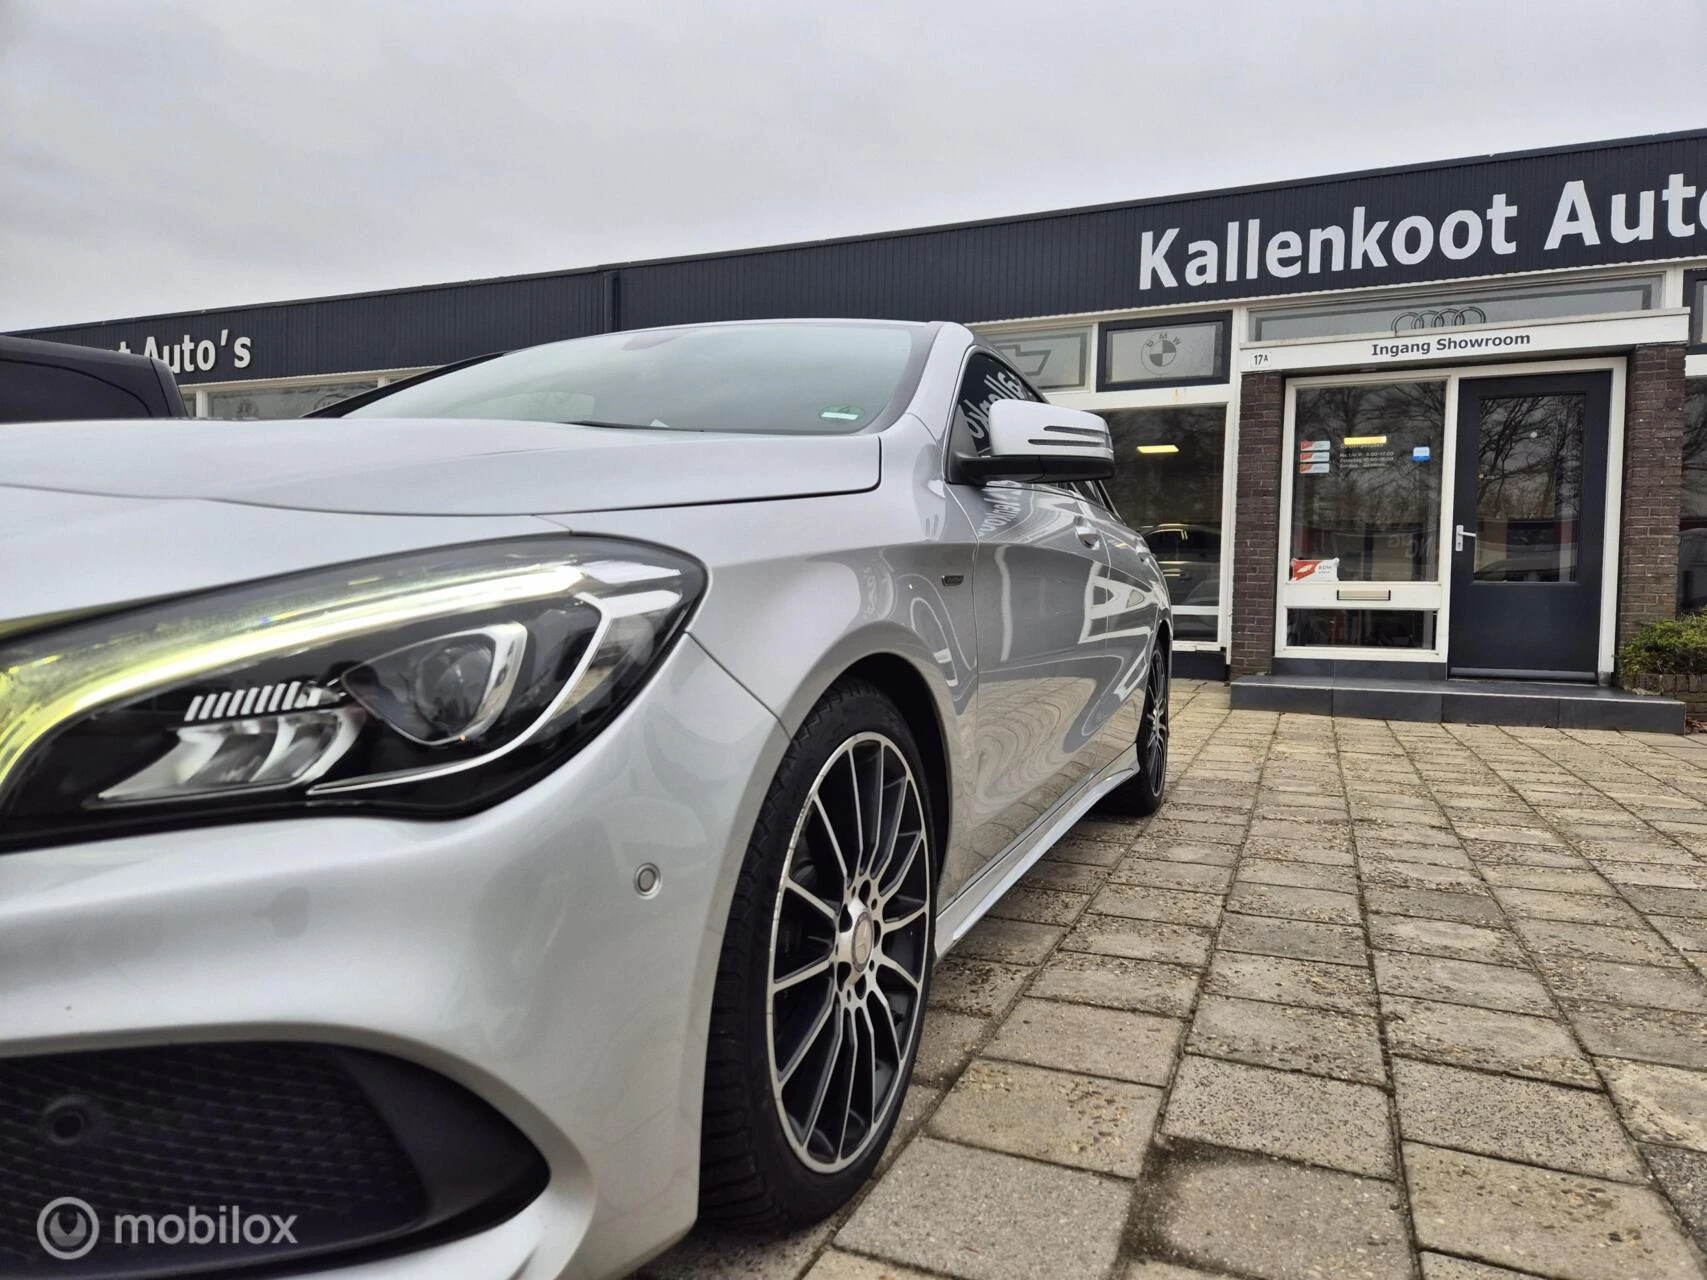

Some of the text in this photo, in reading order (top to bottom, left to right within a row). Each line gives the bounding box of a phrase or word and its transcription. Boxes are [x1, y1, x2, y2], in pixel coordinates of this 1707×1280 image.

[1138, 174, 1707, 291] Kallenkoot Aut
[1372, 333, 1531, 357] Ingang Showroom
[1254, 354, 1269, 365] 17A
